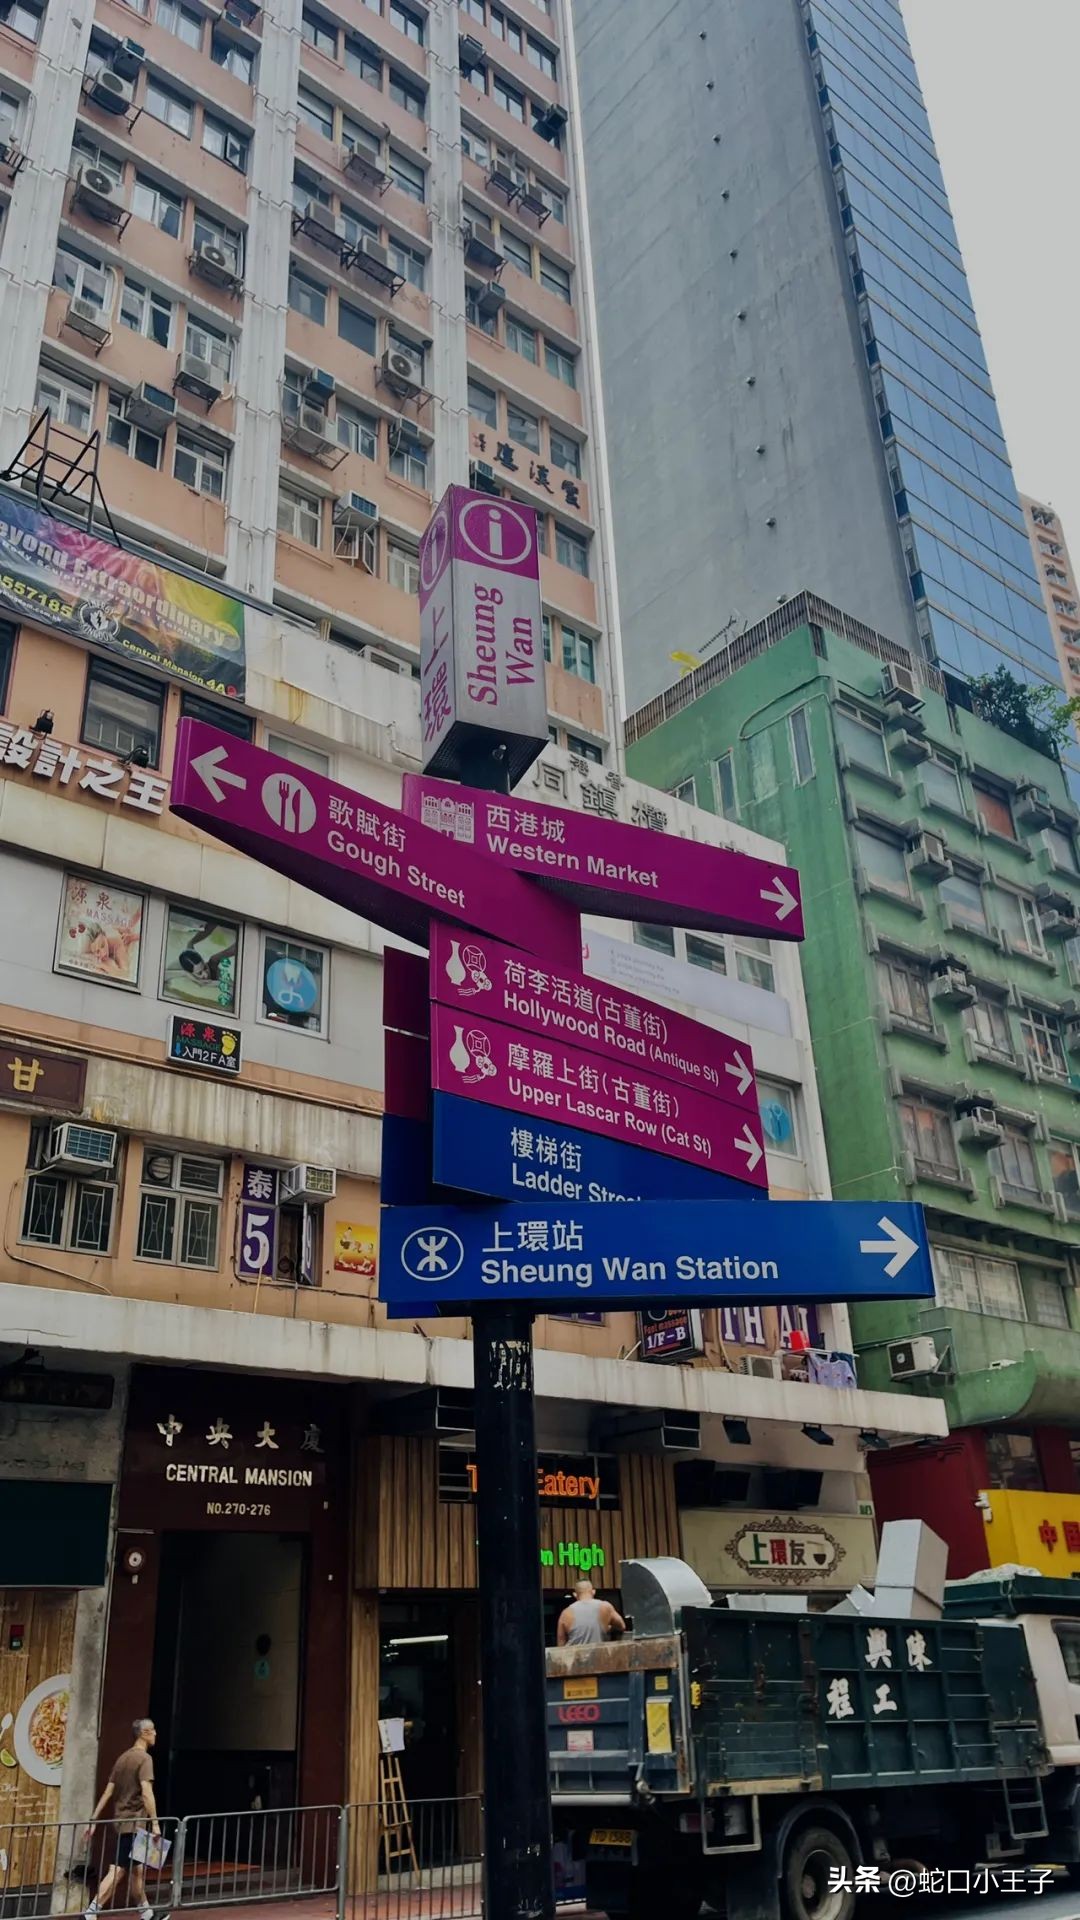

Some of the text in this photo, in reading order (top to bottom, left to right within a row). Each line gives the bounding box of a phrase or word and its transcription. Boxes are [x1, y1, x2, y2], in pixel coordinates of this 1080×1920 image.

[0, 574, 74, 619] 557185
[73, 557, 227, 648] Extraordinary
[123, 638, 226, 696] Central Mansion 4A
[467, 583, 504, 706] Sheung
[506, 616, 536, 686] Wan
[424, 606, 452, 743] 上環
[0, 723, 169, 816] 設計之王
[328, 794, 408, 853] 歌賦街
[486, 802, 566, 845] 西港城
[327, 829, 466, 909] Gough Street
[486, 833, 659, 888] Western Market
[503, 989, 720, 1087] Hollywood Road (Antique St)
[7, 1056, 45, 1093] 甘
[508, 1075, 712, 1159] Upper Lascar Row (Cat St)
[510, 1126, 582, 1173] 樓梯街
[247, 1169, 274, 1200] 泰
[511, 1162, 642, 1202] Ladder Stre
[243, 1212, 270, 1270] 5
[481, 1220, 584, 1253] 上環站
[481, 1256, 780, 1288] Sheung Wan Station
[156, 1413, 325, 1453] 中央大廈
[166, 1463, 313, 1487] CENTRAL MANSION
[206, 1502, 271, 1516] NO.270-276
[558, 1541, 606, 1571] High
[749, 1533, 807, 1566] 上環友
